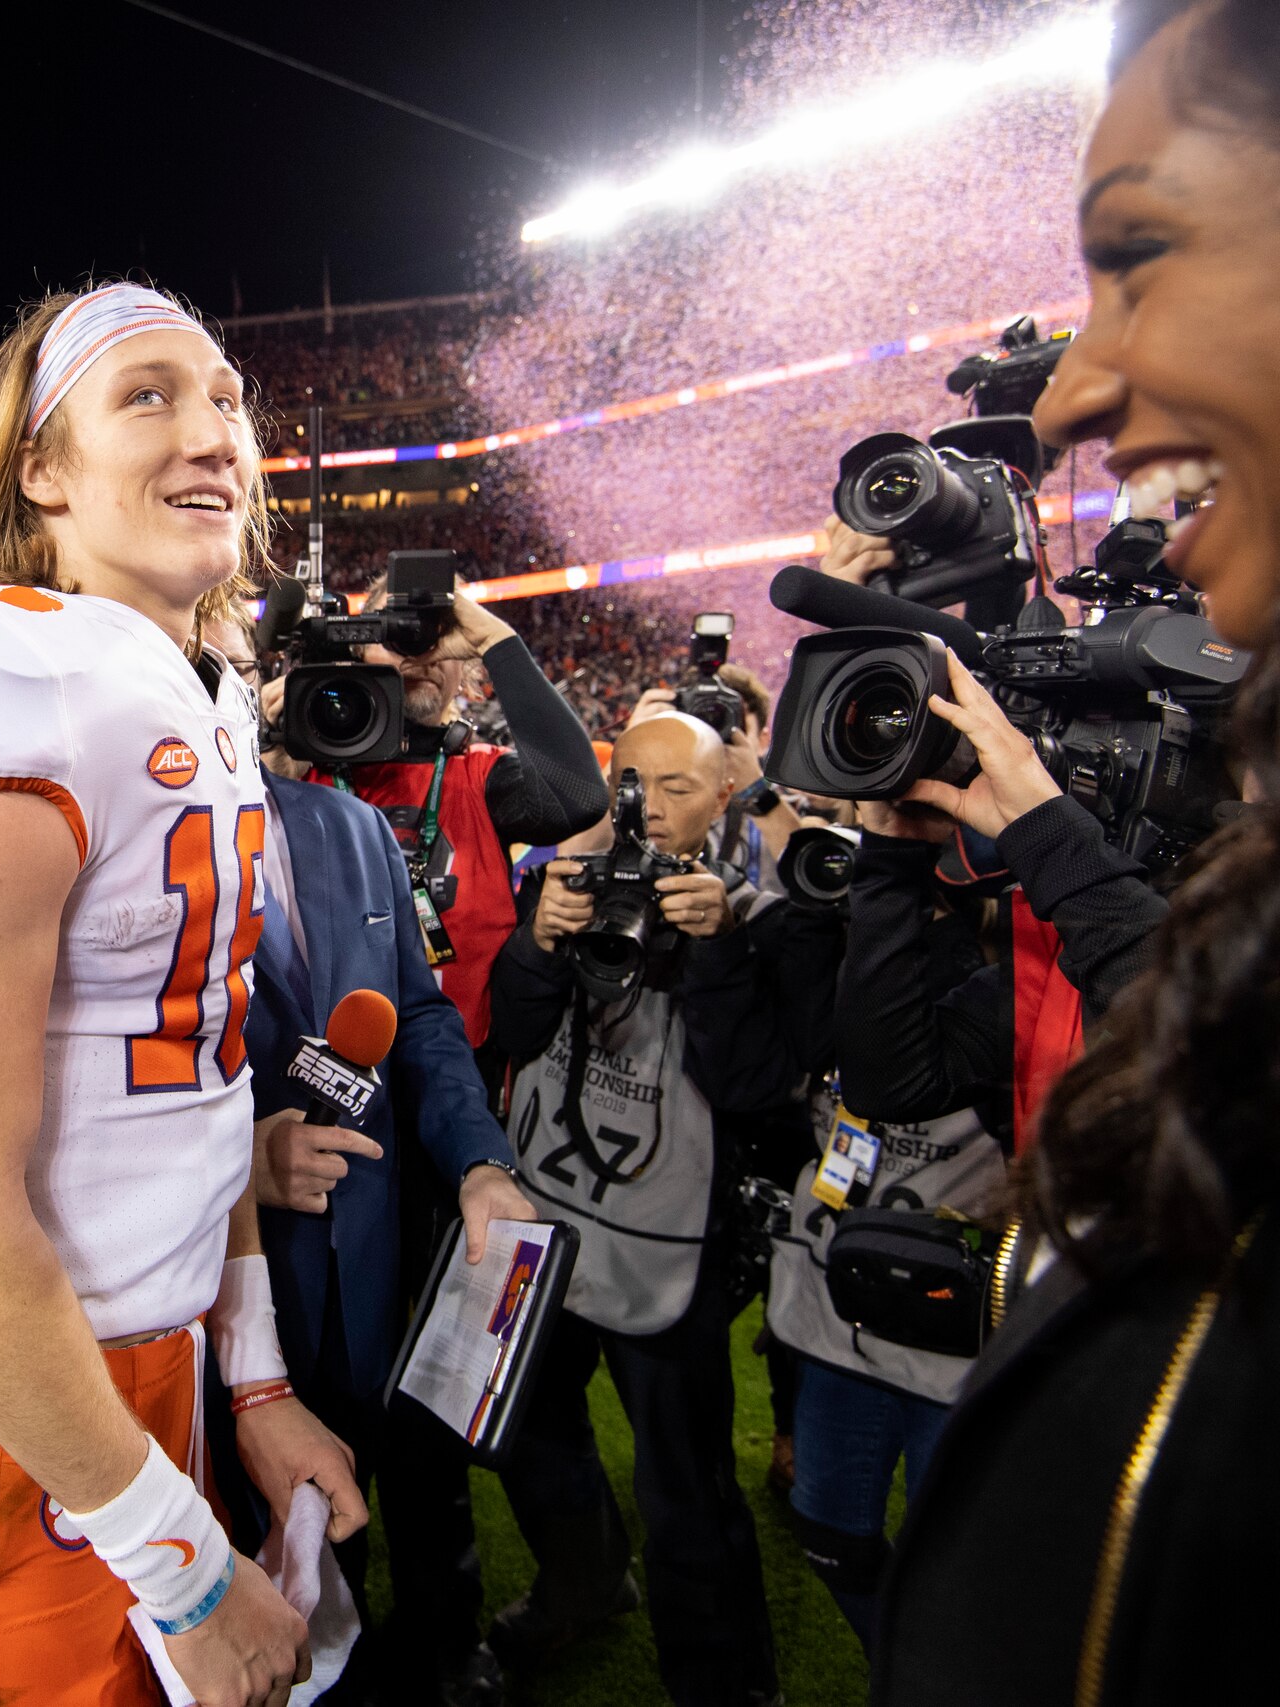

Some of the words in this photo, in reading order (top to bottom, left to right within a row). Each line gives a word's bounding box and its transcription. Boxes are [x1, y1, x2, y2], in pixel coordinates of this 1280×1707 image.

[1016, 630, 1045, 639] SONY
[1200, 648, 1233, 662] Multiscan
[156, 749, 193, 771] ACC
[614, 871, 640, 880] Nikon
[293, 1044, 376, 1105] ESPN
[297, 1068, 355, 1108] RADIO
[593, 1092, 627, 1115] 2019
